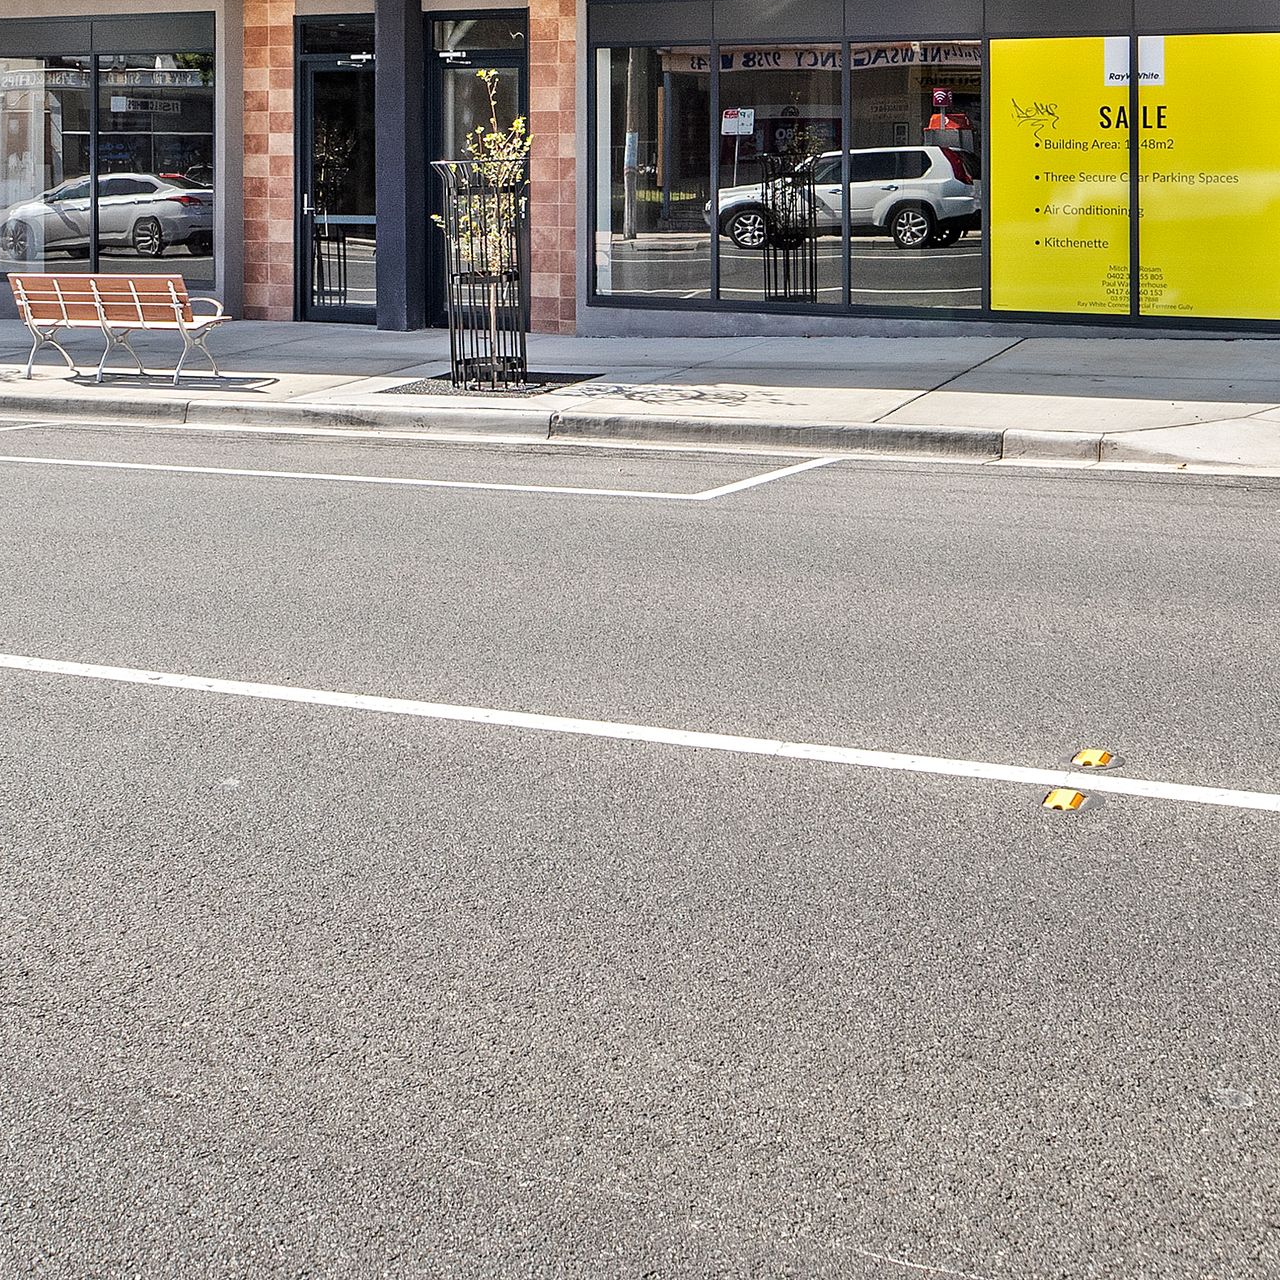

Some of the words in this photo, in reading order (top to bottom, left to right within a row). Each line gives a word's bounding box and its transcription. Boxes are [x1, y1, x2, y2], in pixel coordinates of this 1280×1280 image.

[1099, 105, 1167, 129] SALE
[1044, 139, 1089, 151] Building
[1091, 139, 1120, 150] Area:
[1044, 172, 1076, 183] Three
[1079, 172, 1117, 183] Secure
[1152, 172, 1195, 185] Parking
[1198, 173, 1239, 186] Spaces
[1043, 205, 1060, 215] Air
[1044, 238, 1109, 249] Kitchenette
